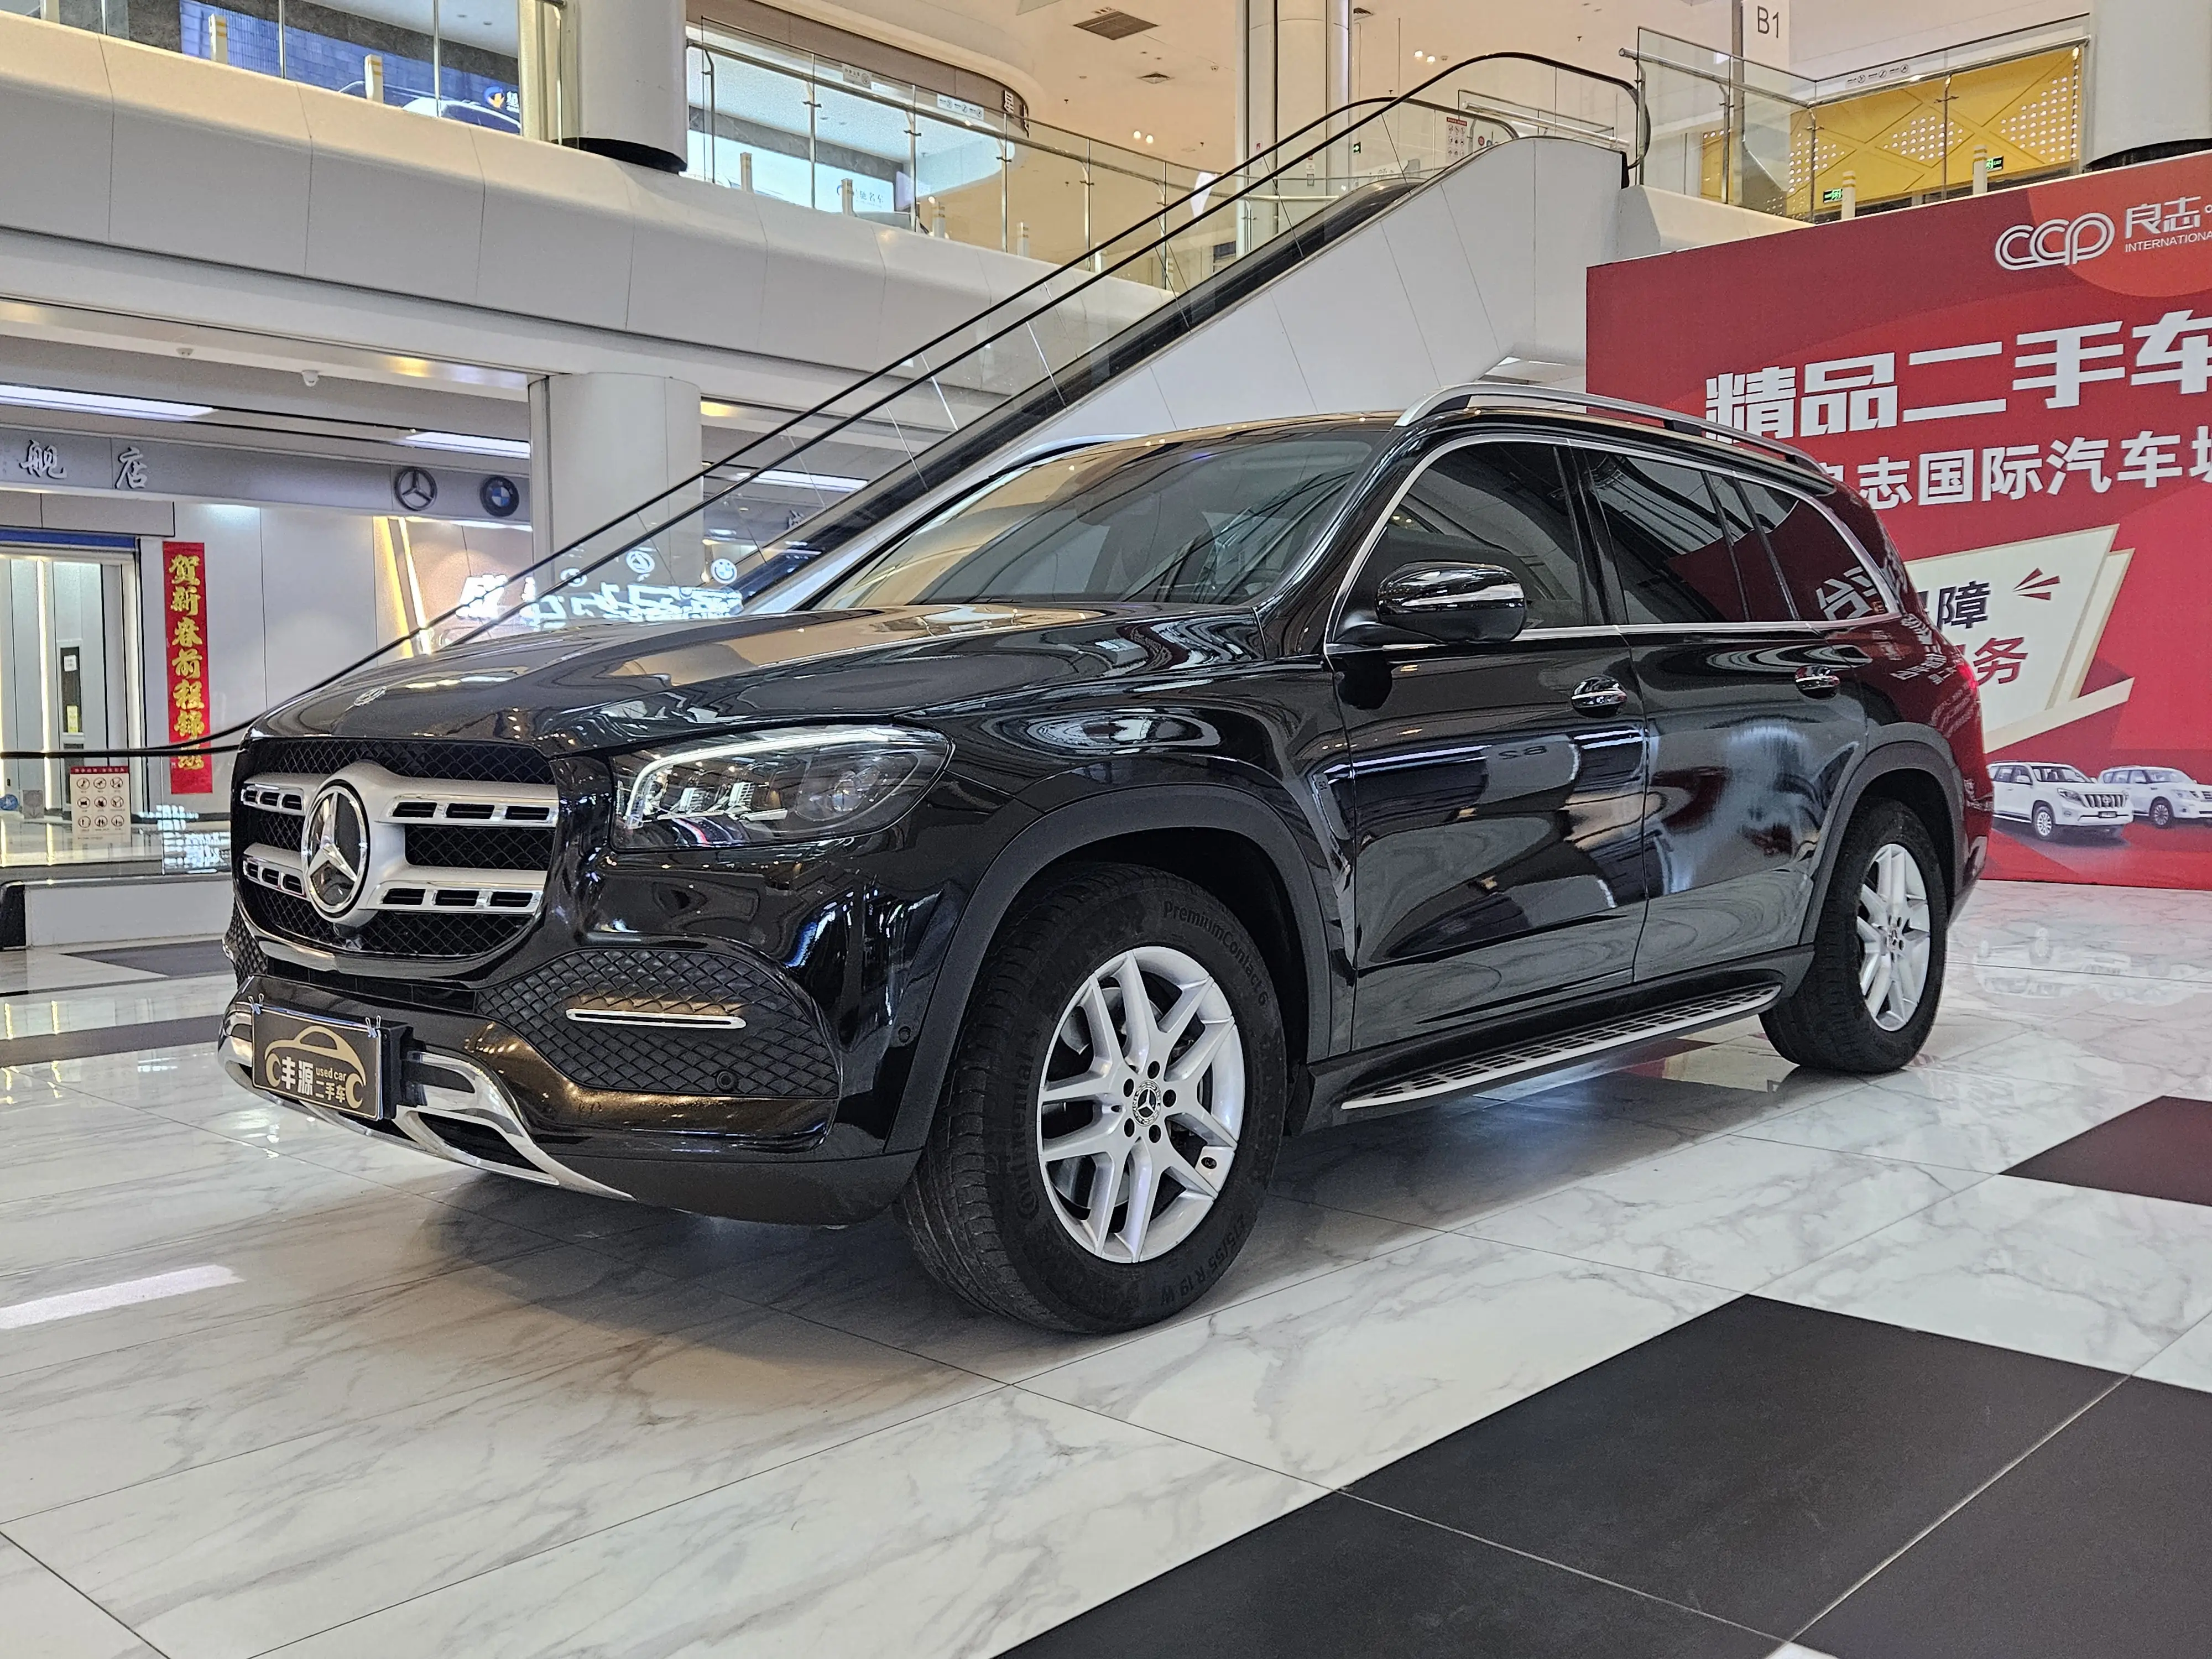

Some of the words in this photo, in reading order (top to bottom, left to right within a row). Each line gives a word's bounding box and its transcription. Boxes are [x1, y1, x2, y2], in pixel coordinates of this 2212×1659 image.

[1757, 5, 1778, 39] B1
[2125, 196, 2201, 239] 良志
[1707, 310, 2212, 444] 精品二手车
[1917, 581, 1991, 632] 障
[1953, 637, 2028, 686] 务
[1258, 990, 1269, 1007] 6
[281, 1056, 314, 1095] 丰源
[315, 1067, 333, 1079] used
[333, 1071, 347, 1082] car
[315, 1080, 346, 1103] 二手车
